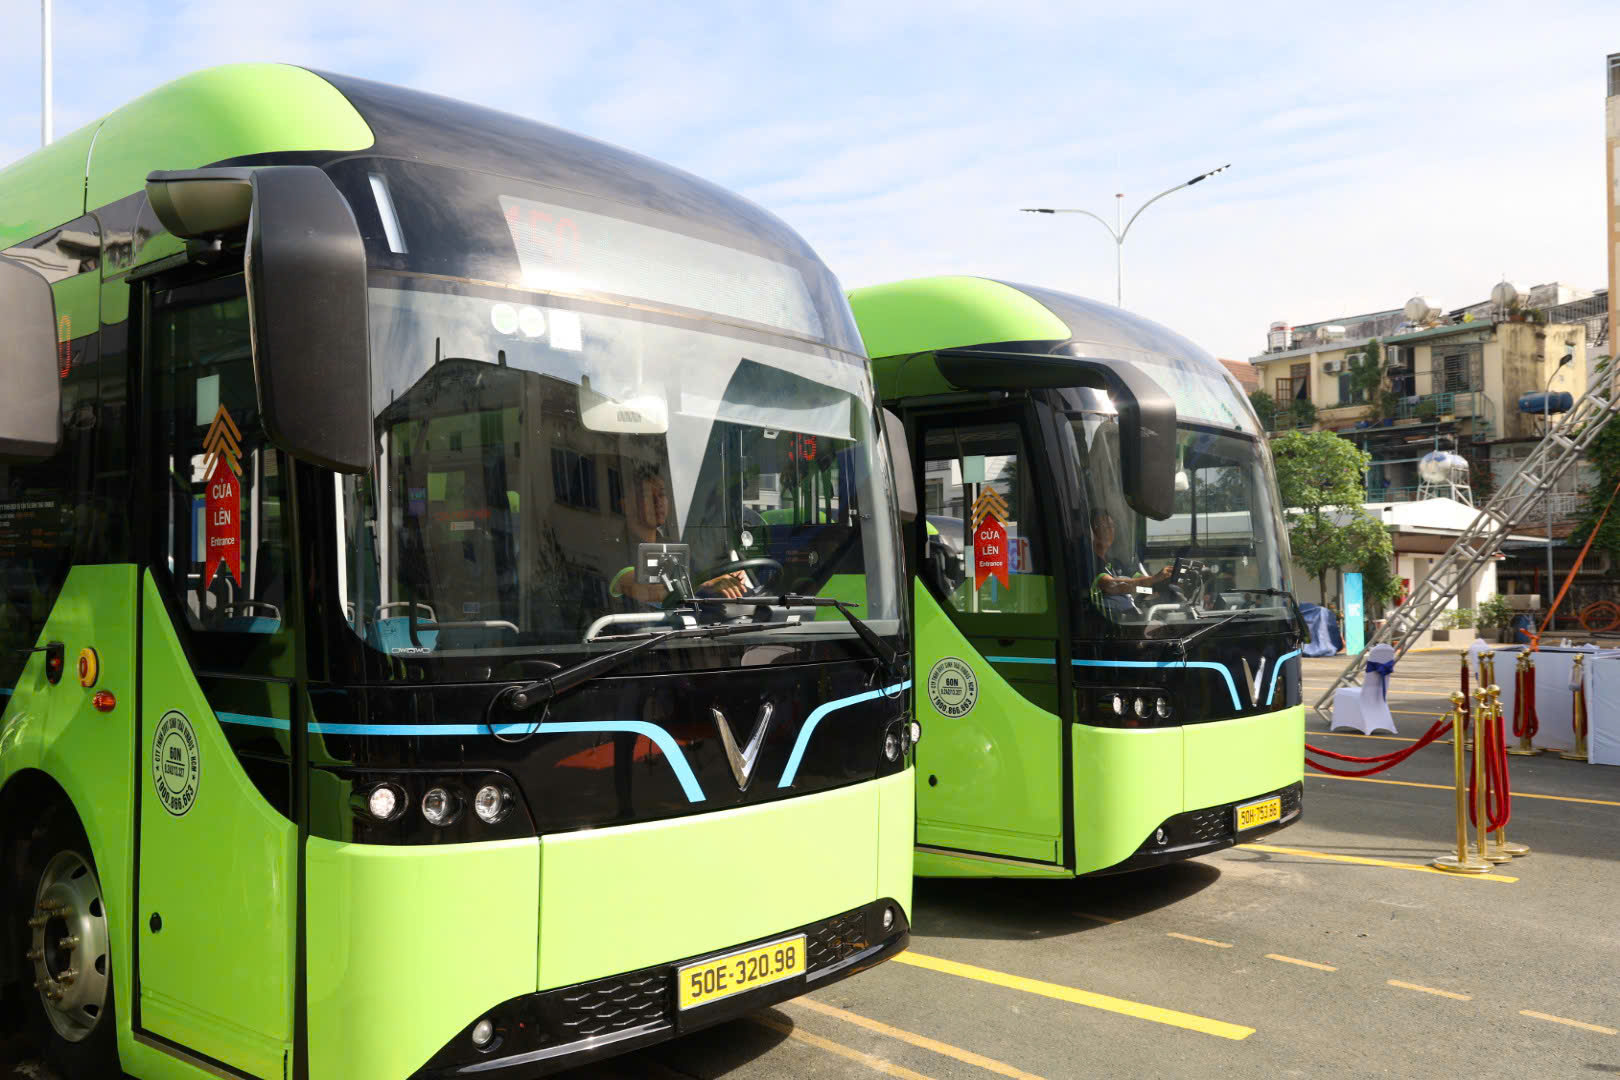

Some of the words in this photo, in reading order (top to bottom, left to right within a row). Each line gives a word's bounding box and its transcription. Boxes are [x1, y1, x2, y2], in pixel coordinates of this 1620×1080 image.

[212, 478, 232, 499] CỬA
[214, 507, 231, 526] LÊN
[210, 537, 235, 547] Entrance
[980, 528, 1000, 540] CỬA
[982, 544, 999, 555] LÊN
[934, 696, 972, 714] 1900.866.663
[156, 775, 195, 810] 1900.866.663
[691, 946, 796, 998] 50E-320.98
